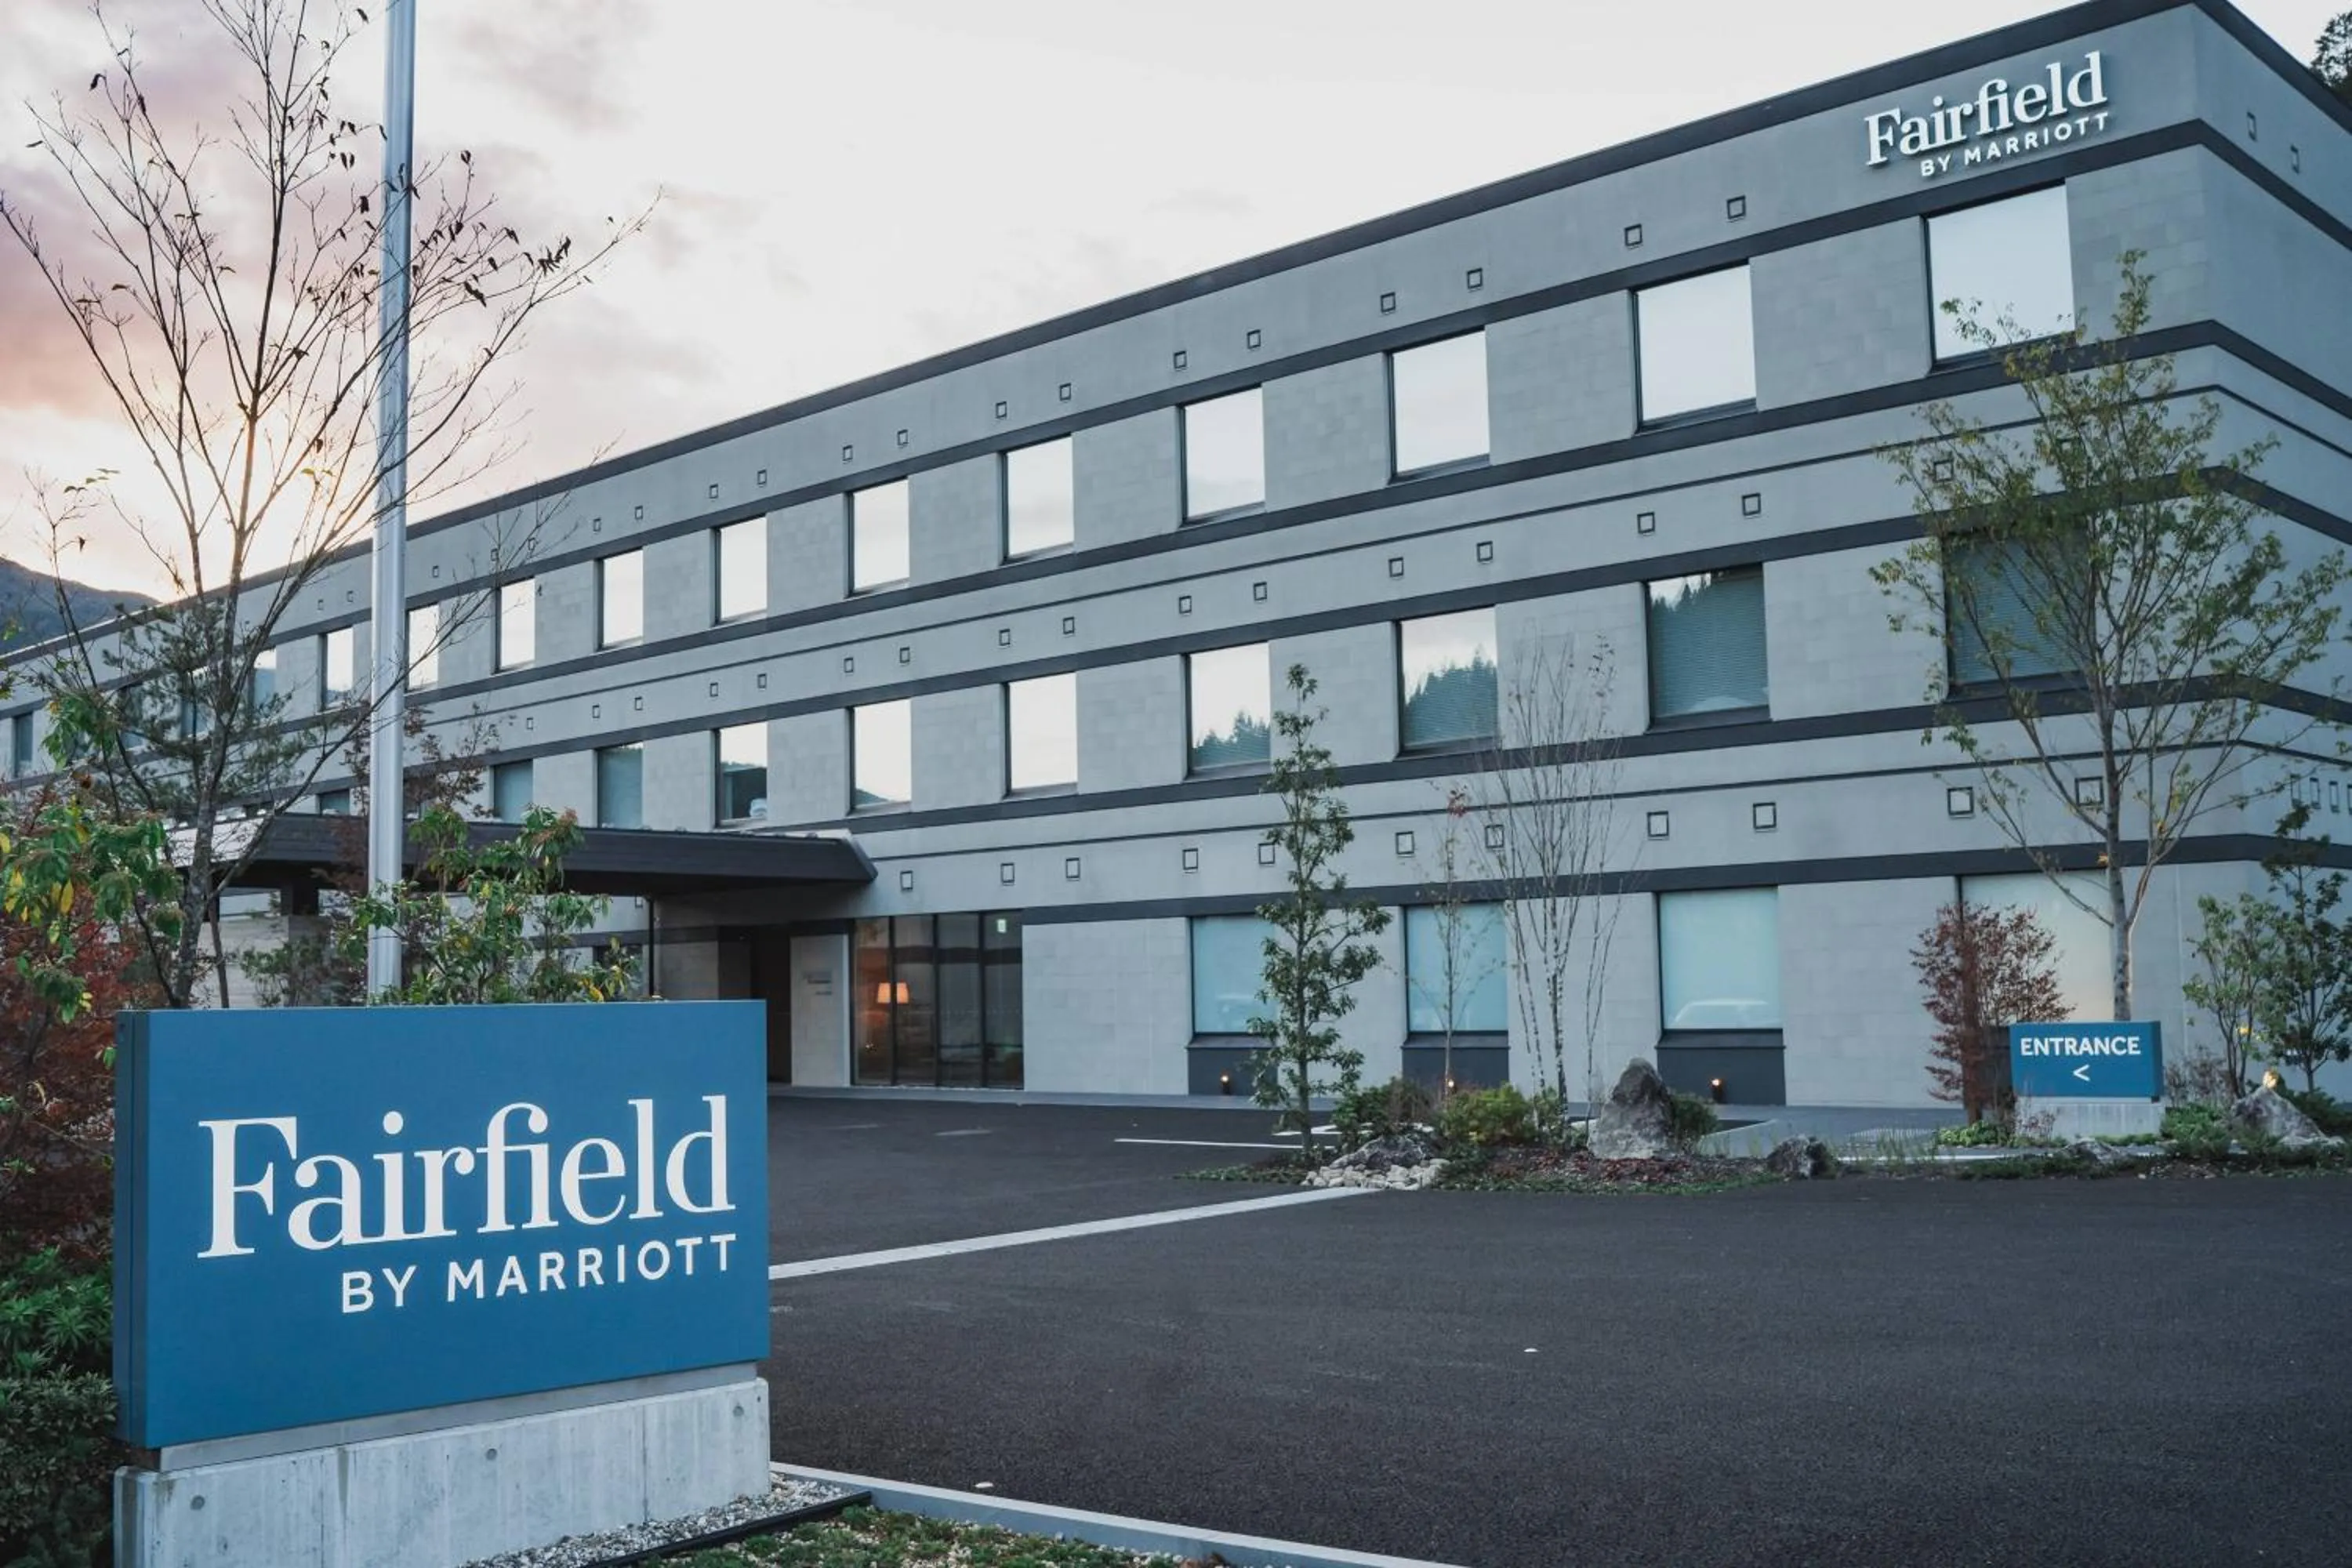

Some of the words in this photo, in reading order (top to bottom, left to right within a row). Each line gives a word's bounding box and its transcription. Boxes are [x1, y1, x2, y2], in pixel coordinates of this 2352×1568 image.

[1864, 51, 2107, 165] Fairfield
[1921, 154, 1951, 176] BY
[1964, 112, 2109, 165] MARRIOTT
[2020, 1036, 2141, 1056] ENTRANCE
[197, 1094, 737, 1259] Fairfield
[342, 1265, 417, 1314] BY
[447, 1233, 737, 1303] MARRIOTT
